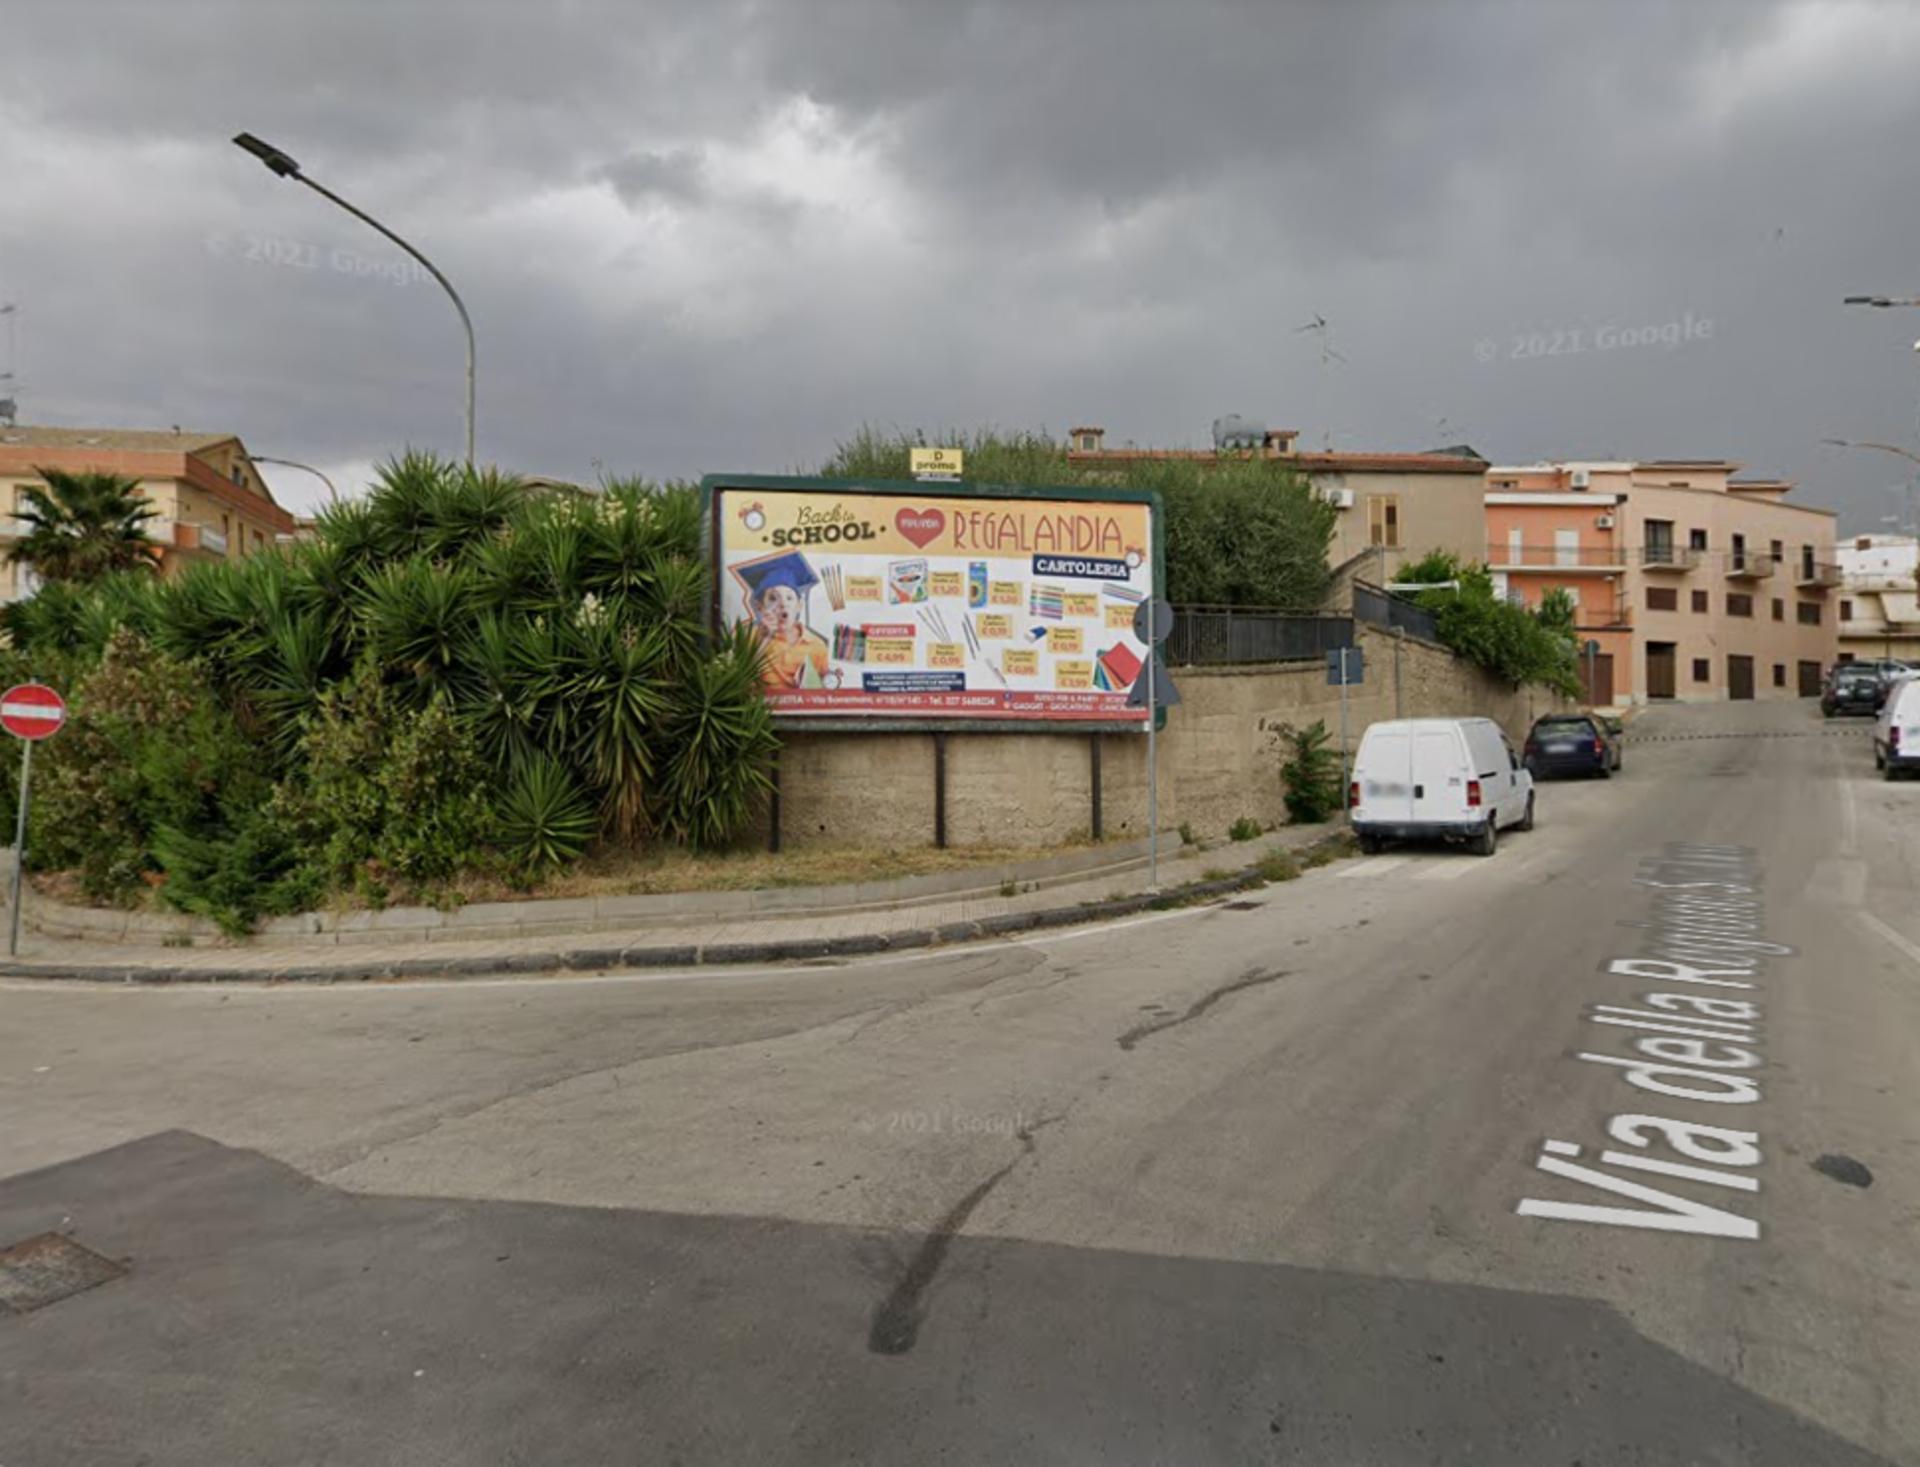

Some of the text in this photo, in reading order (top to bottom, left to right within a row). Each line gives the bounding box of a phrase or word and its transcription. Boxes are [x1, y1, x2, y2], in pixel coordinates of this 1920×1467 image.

[796, 502, 843, 527] Back
[771, 521, 876, 548] SCHOOL
[953, 509, 1123, 553] REGALANDIA
[1036, 558, 1128, 577] CARTOLERIA
[868, 626, 910, 636] OFFERTA
